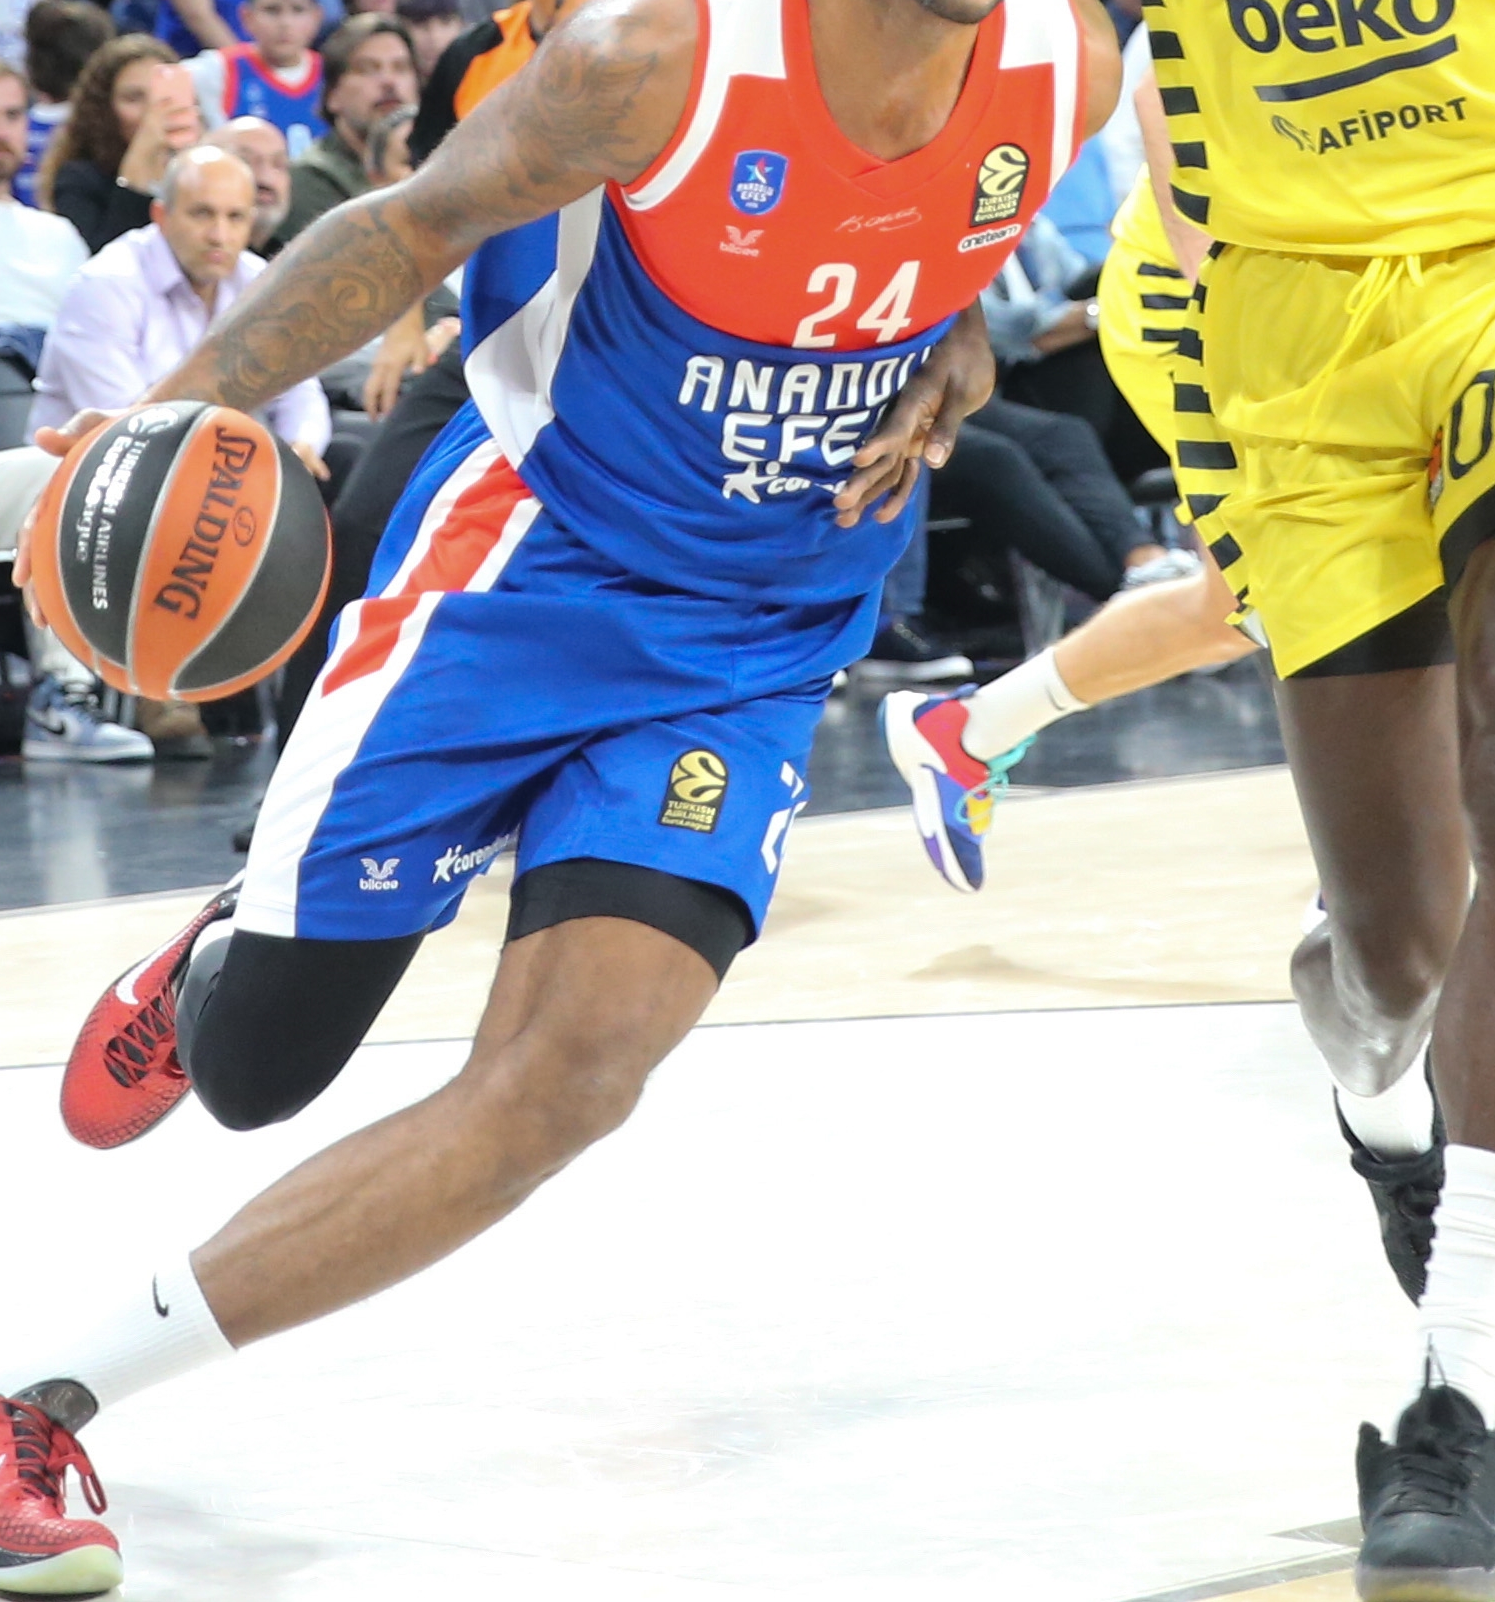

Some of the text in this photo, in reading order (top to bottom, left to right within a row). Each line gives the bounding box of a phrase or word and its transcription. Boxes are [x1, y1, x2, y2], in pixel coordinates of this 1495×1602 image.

[791, 260, 921, 349] 24
[721, 404, 887, 467] EFE
[154, 427, 257, 620] SPALDING
